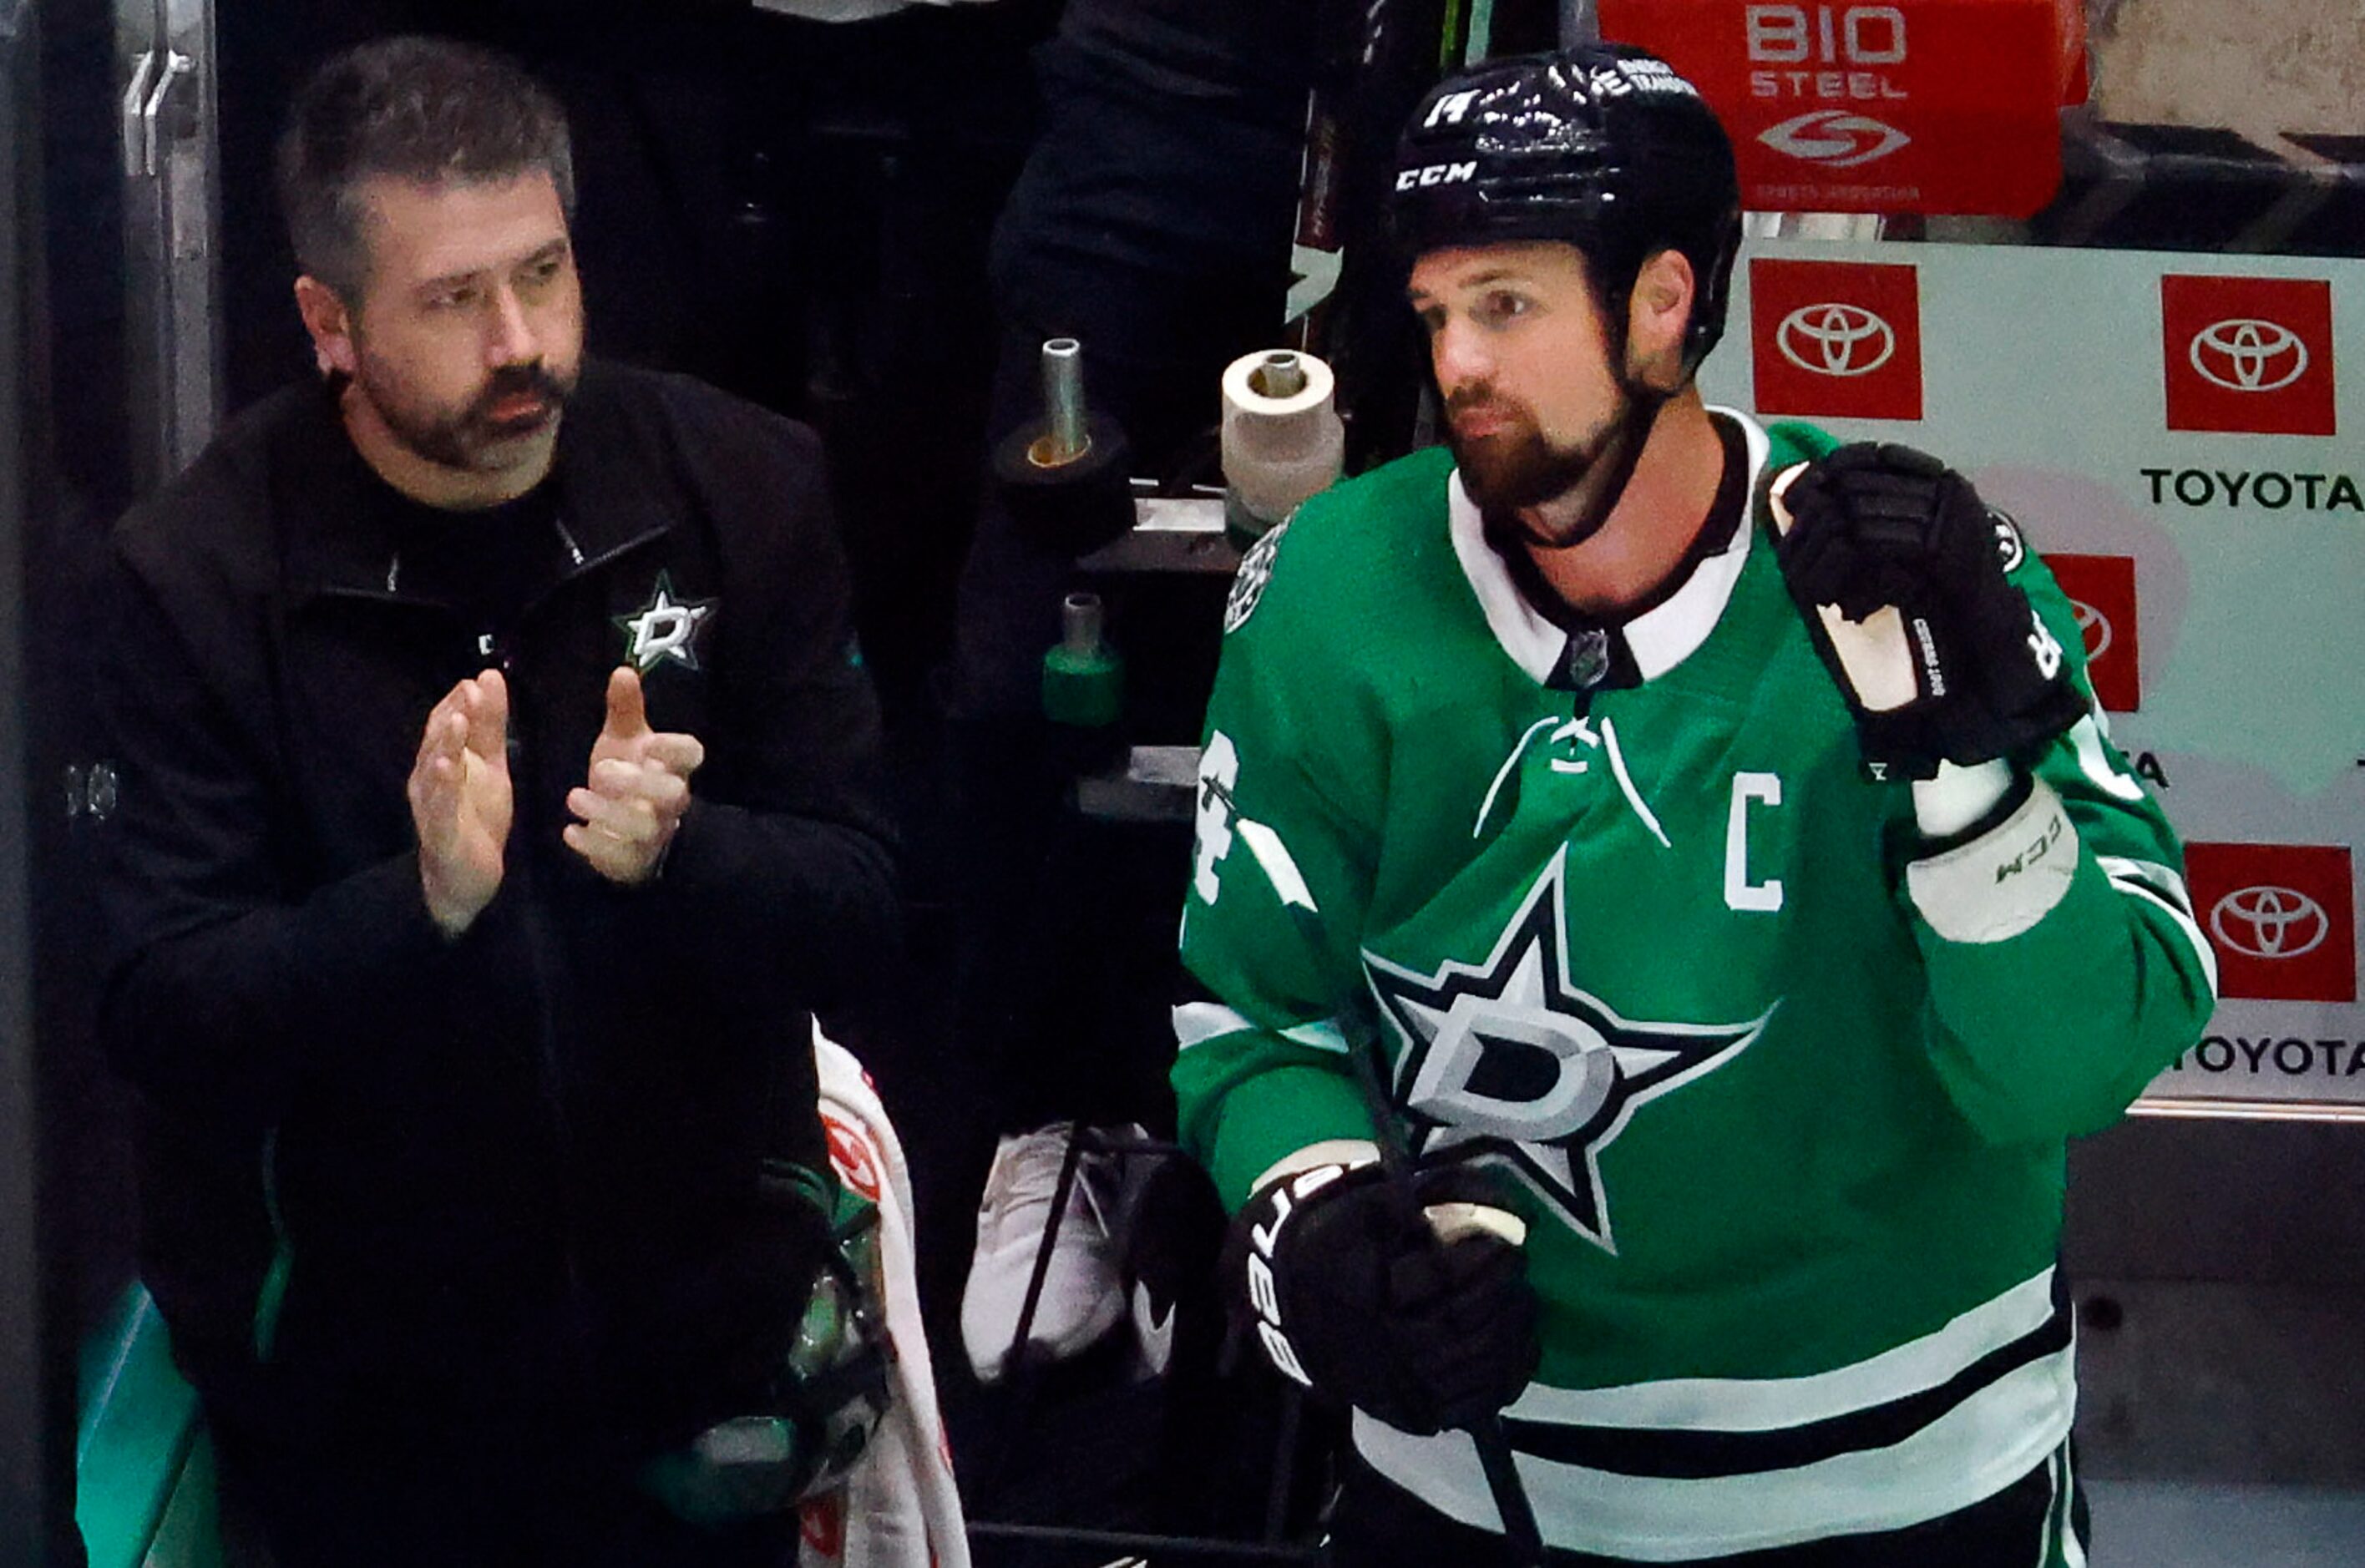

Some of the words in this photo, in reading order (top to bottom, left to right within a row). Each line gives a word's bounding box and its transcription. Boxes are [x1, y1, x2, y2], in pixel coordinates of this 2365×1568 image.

[1745, 4, 1907, 63] BIO
[1423, 89, 1482, 128] 14
[1750, 70, 1908, 99] STEEL
[1395, 160, 1478, 191] CCM
[2140, 468, 2365, 512] TOYOTA
[1724, 771, 1784, 913] C
[1995, 814, 2062, 885] CCM
[1248, 1159, 1380, 1386] BAUE
